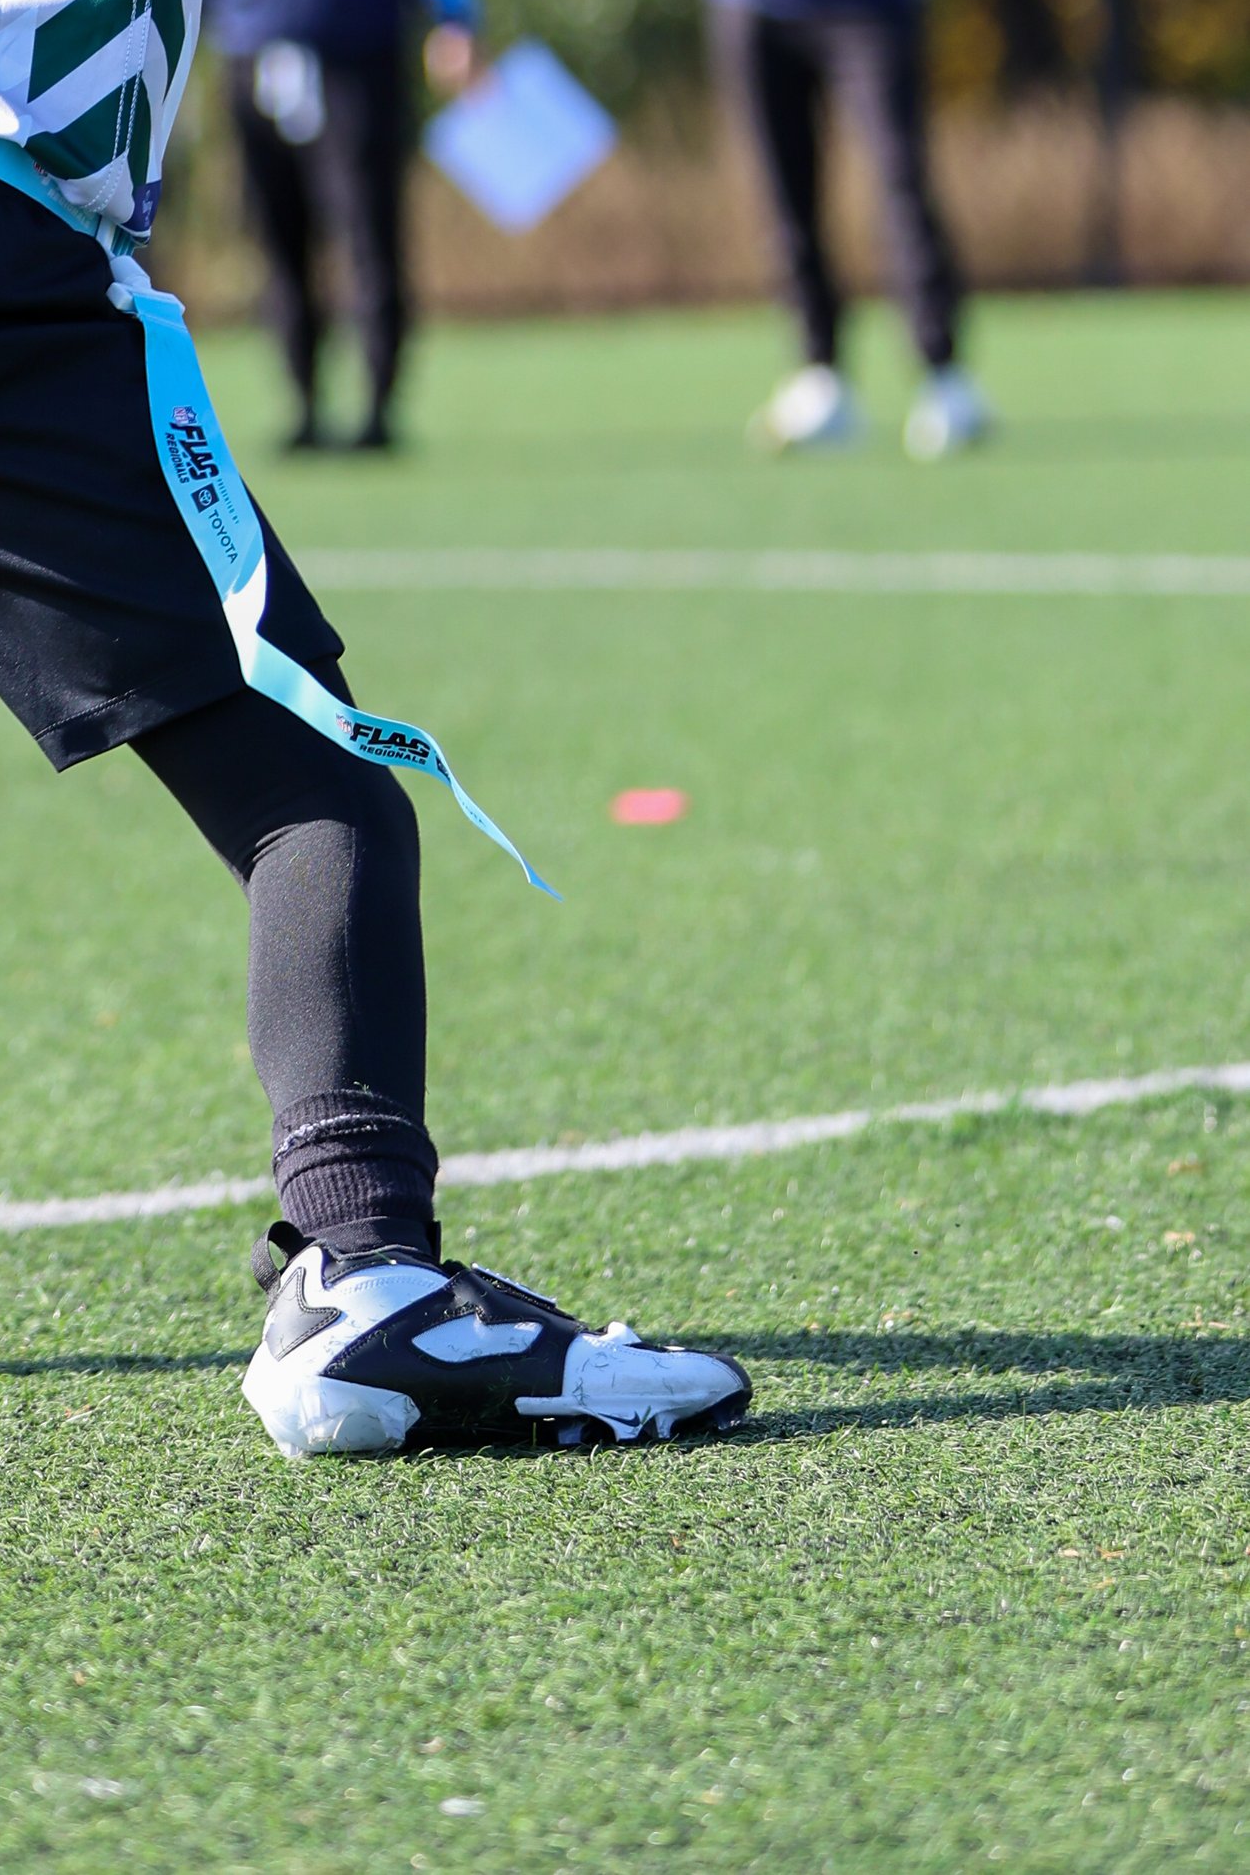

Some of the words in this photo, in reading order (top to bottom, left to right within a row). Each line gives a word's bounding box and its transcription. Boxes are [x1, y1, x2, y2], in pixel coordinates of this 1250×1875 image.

[165, 432, 190, 484] REGIONALS
[169, 422, 220, 481] FLAG
[208, 509, 239, 564] TOYOTA
[350, 722, 430, 757] FLAG
[359, 744, 426, 765] REGIONALS
